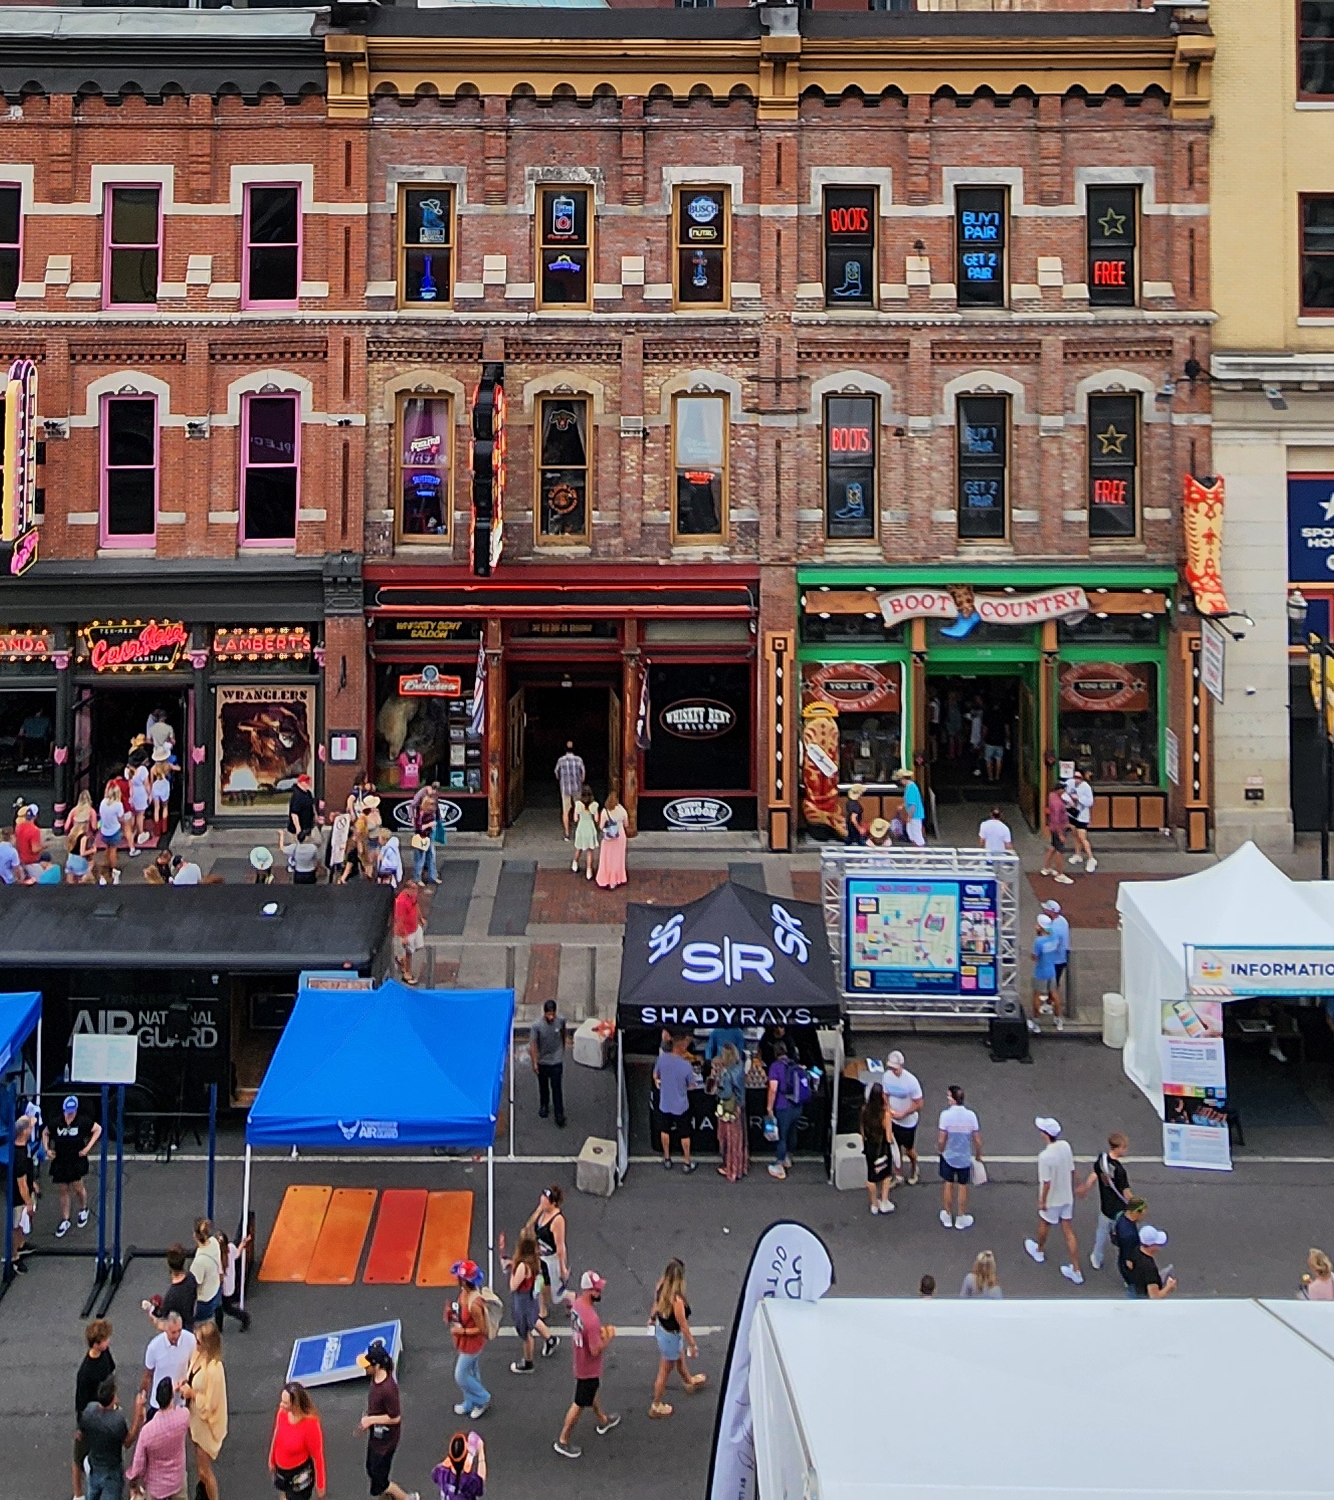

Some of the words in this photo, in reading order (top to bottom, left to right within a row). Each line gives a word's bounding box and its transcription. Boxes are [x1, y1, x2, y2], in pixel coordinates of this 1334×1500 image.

[687, 204, 718, 214] BUSCH
[830, 207, 869, 232] BOOTS
[962, 211, 993, 226] BUY
[964, 227, 998, 241] PAIR
[963, 253, 986, 267] GET
[987, 253, 997, 267] 2
[967, 267, 994, 280] PAIR
[1094, 261, 1126, 285] FREE
[832, 427, 870, 451] BOOTS
[964, 426, 991, 440] BUY
[964, 480, 986, 494] GET
[988, 480, 998, 494] 2
[1094, 479, 1128, 505] FREE
[889, 596, 951, 616] BOOT
[980, 588, 1083, 618] COUNTRY
[214, 634, 311, 652] LAMBERT'S
[829, 682, 849, 690] YOU
[850, 682, 869, 690] GET
[222, 690, 308, 701] WRANGLERS
[665, 706, 706, 724] WHISKEY
[677, 723, 719, 731] SALOON
[138, 1010, 217, 1025] NATNAL
[68, 1010, 135, 1047] AIR
[358, 1126, 377, 1139] AIR
